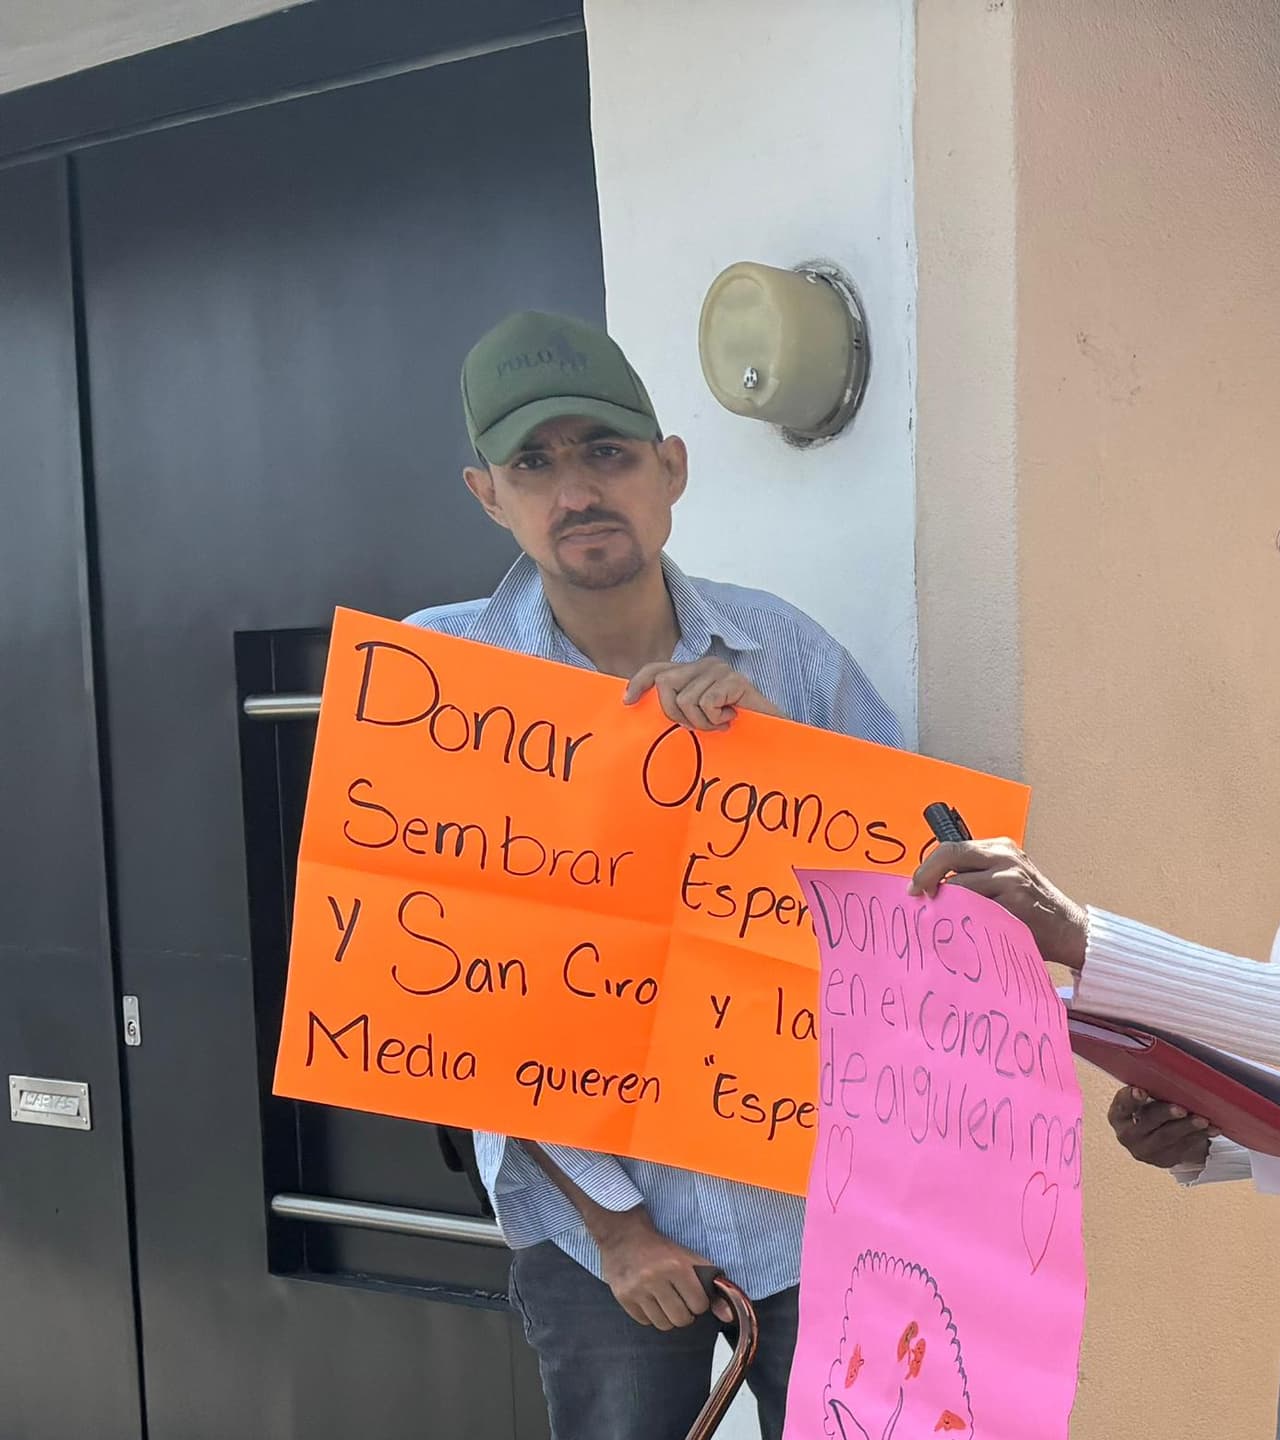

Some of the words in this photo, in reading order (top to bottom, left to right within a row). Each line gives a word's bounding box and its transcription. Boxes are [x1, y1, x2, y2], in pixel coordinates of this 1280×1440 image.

[354, 641, 594, 782] Donar
[642, 722, 906, 865] Organos
[343, 777, 634, 887] Sembrar
[680, 852, 818, 938] Esper
[391, 890, 528, 997] San
[563, 942, 659, 1005] Ciro
[710, 994, 732, 1029] y
[775, 986, 818, 1041] la
[823, 968, 868, 1017] en
[881, 984, 909, 1032] el
[305, 1010, 477, 1081] Media
[516, 1060, 661, 1107] quieren
[703, 1054, 819, 1142] "Espe
